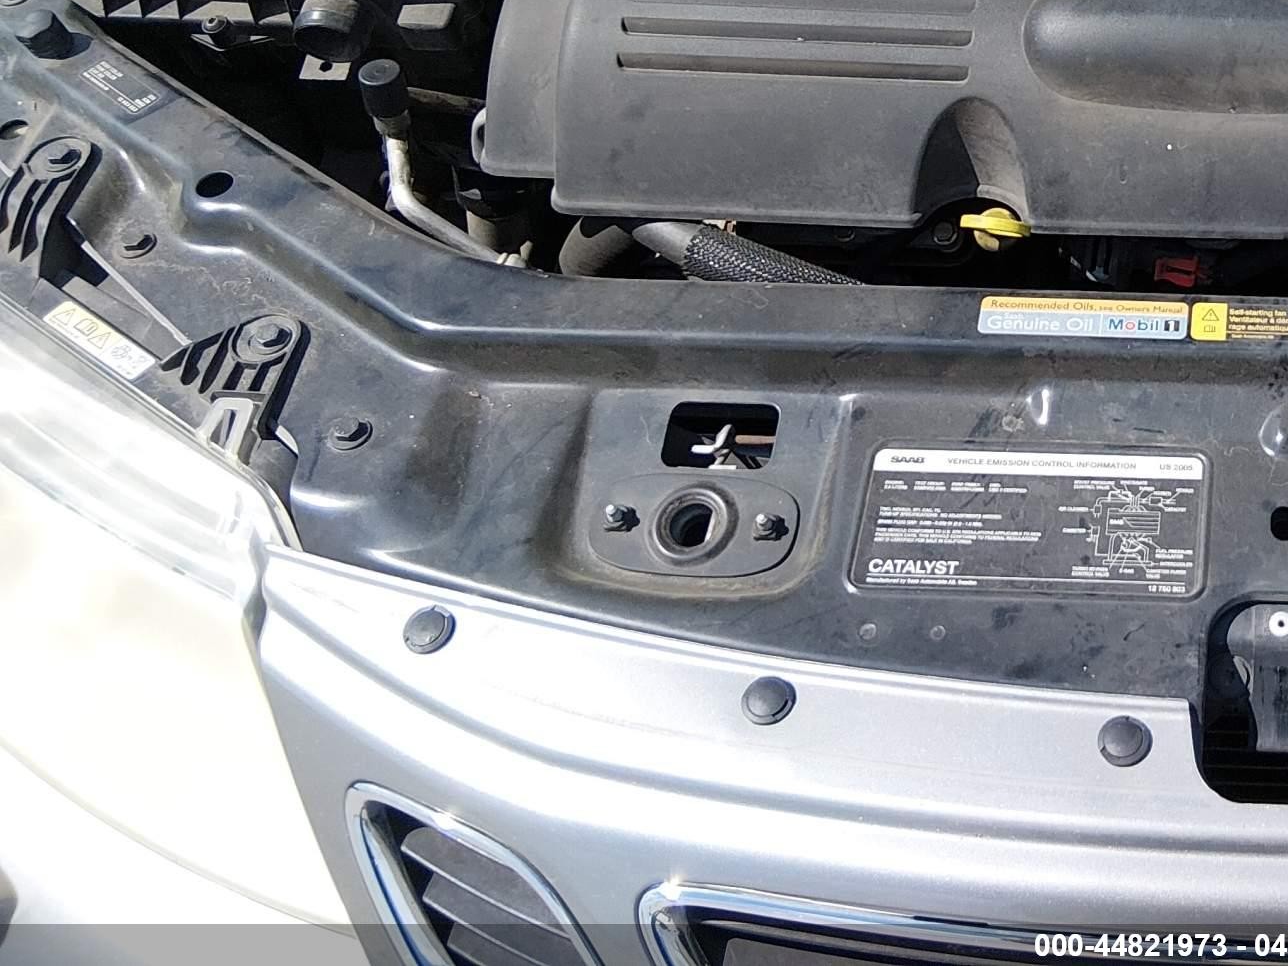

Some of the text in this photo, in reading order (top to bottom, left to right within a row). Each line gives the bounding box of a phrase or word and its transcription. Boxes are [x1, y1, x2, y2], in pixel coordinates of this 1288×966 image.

[991, 300, 1069, 310] Recommended
[1073, 303, 1097, 311] Oils,
[987, 318, 1093, 332] Genuine Oil
[1109, 318, 1159, 331] Mobil
[1076, 461, 1136, 469] INFORMATION
[868, 559, 959, 574] CATALYST
